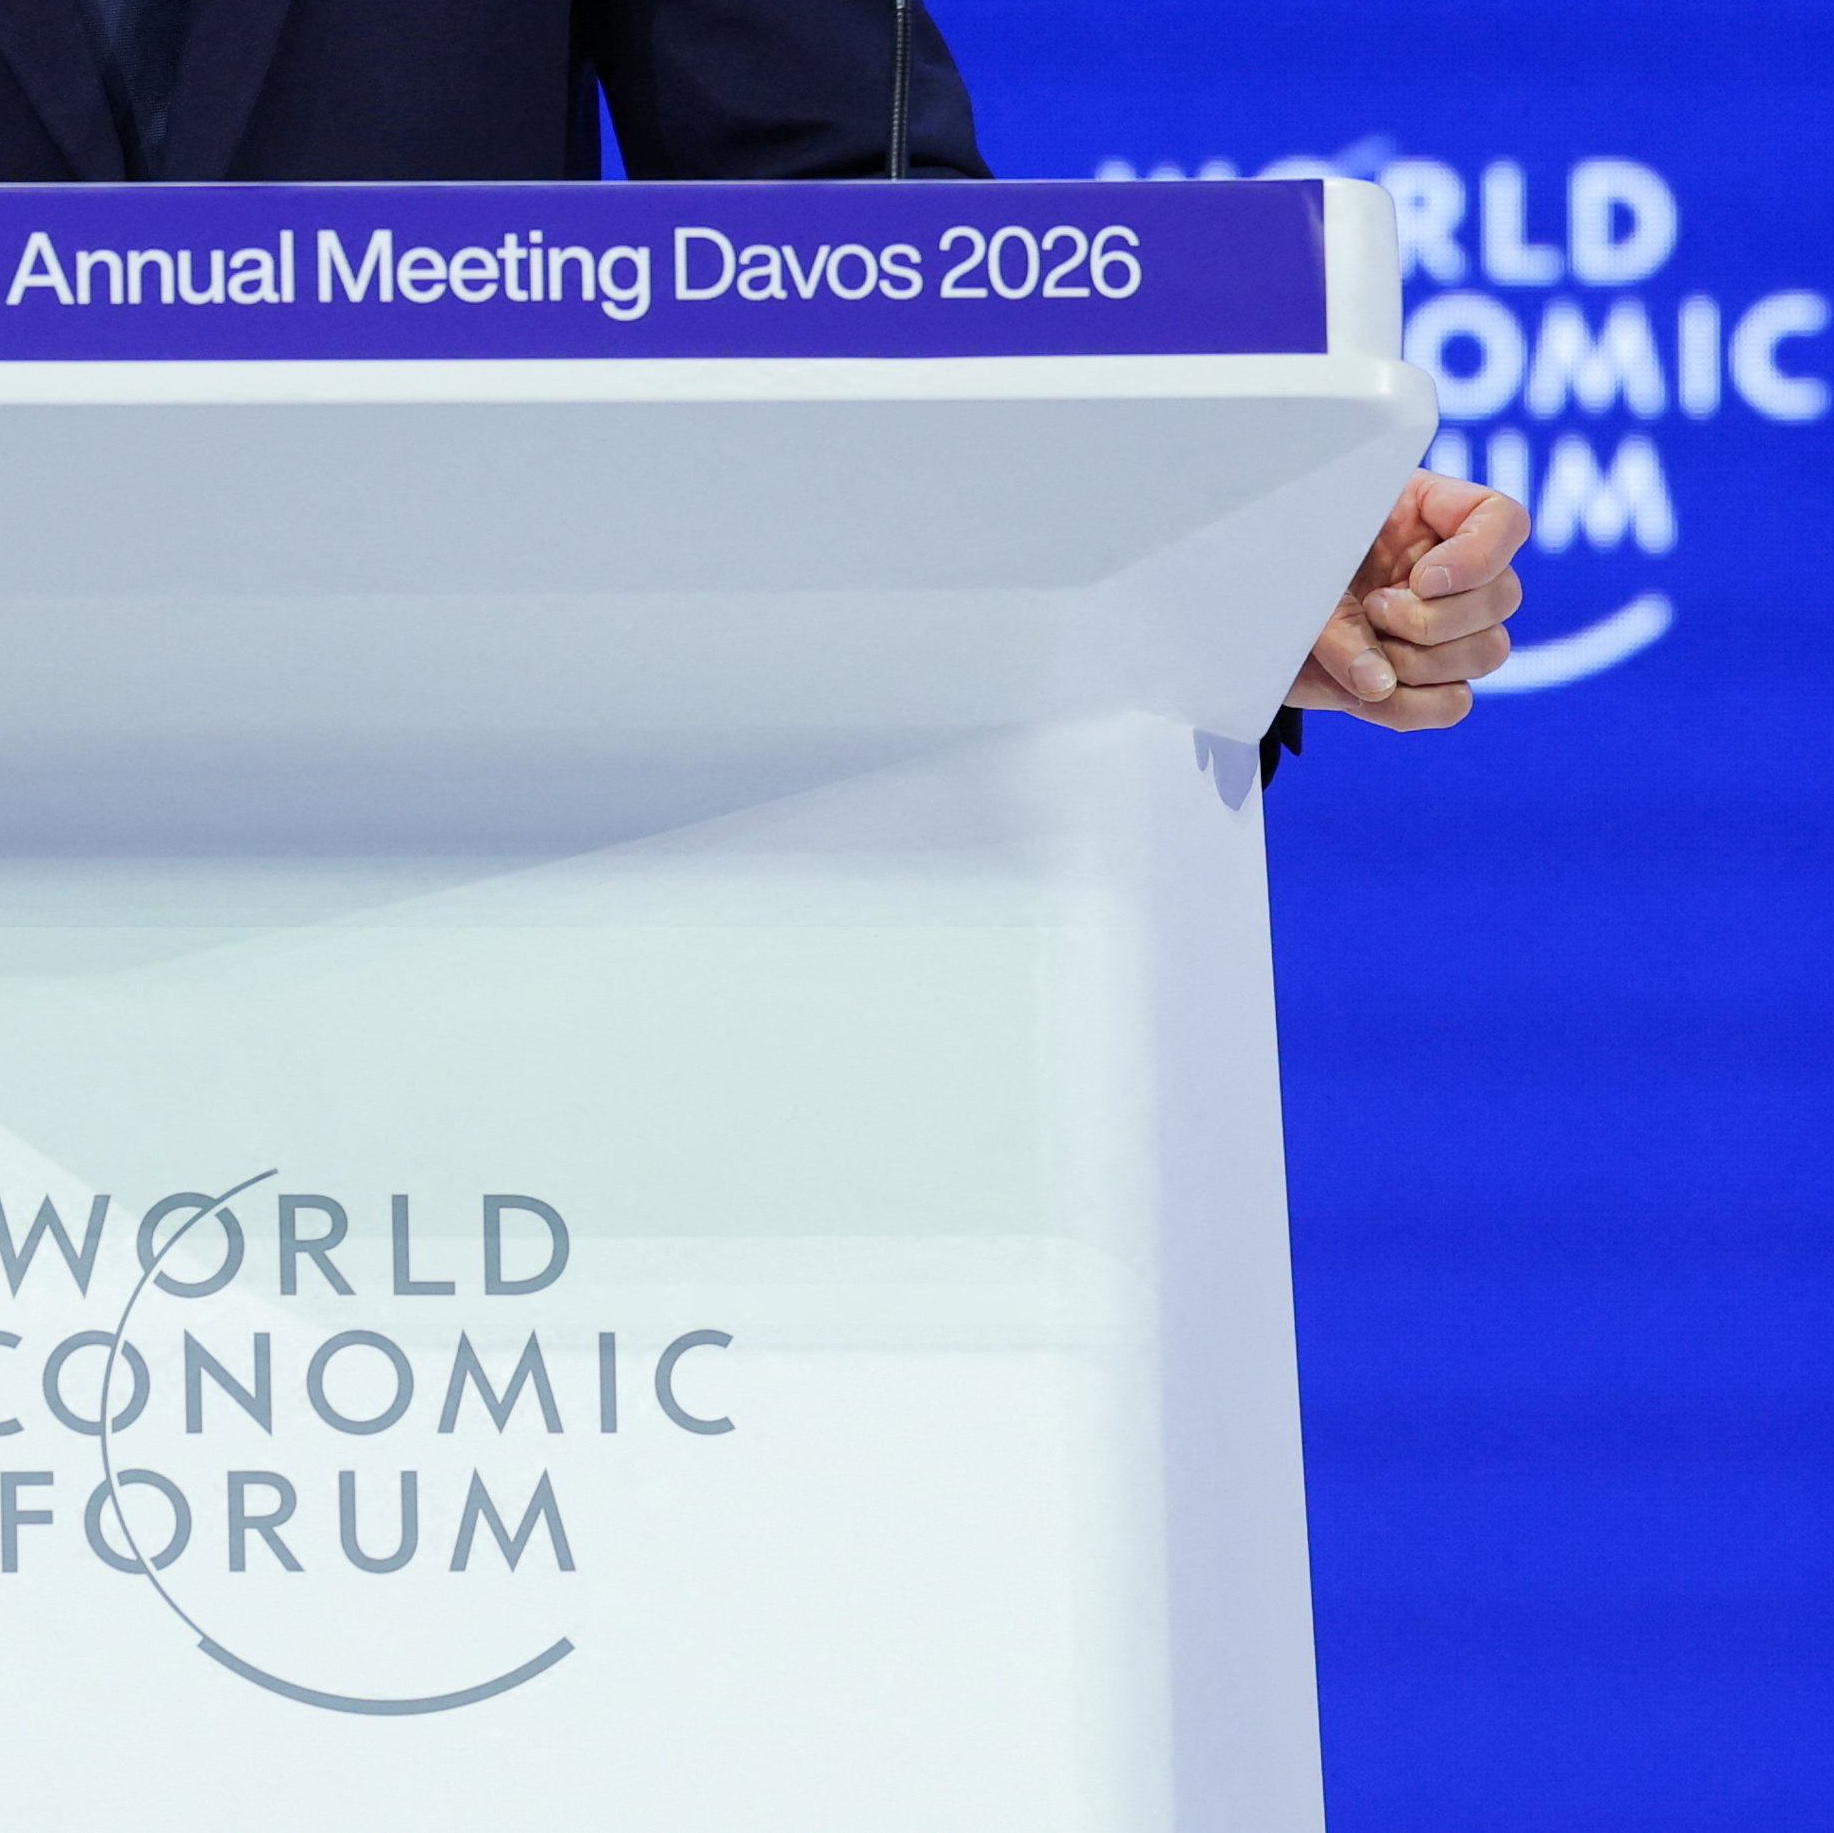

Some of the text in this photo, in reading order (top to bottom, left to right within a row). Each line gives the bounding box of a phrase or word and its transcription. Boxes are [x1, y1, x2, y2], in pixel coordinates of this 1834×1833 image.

[4, 223, 1144, 324] Annual Meeting Davos 2026
[1096, 155, 1678, 285] RLD
